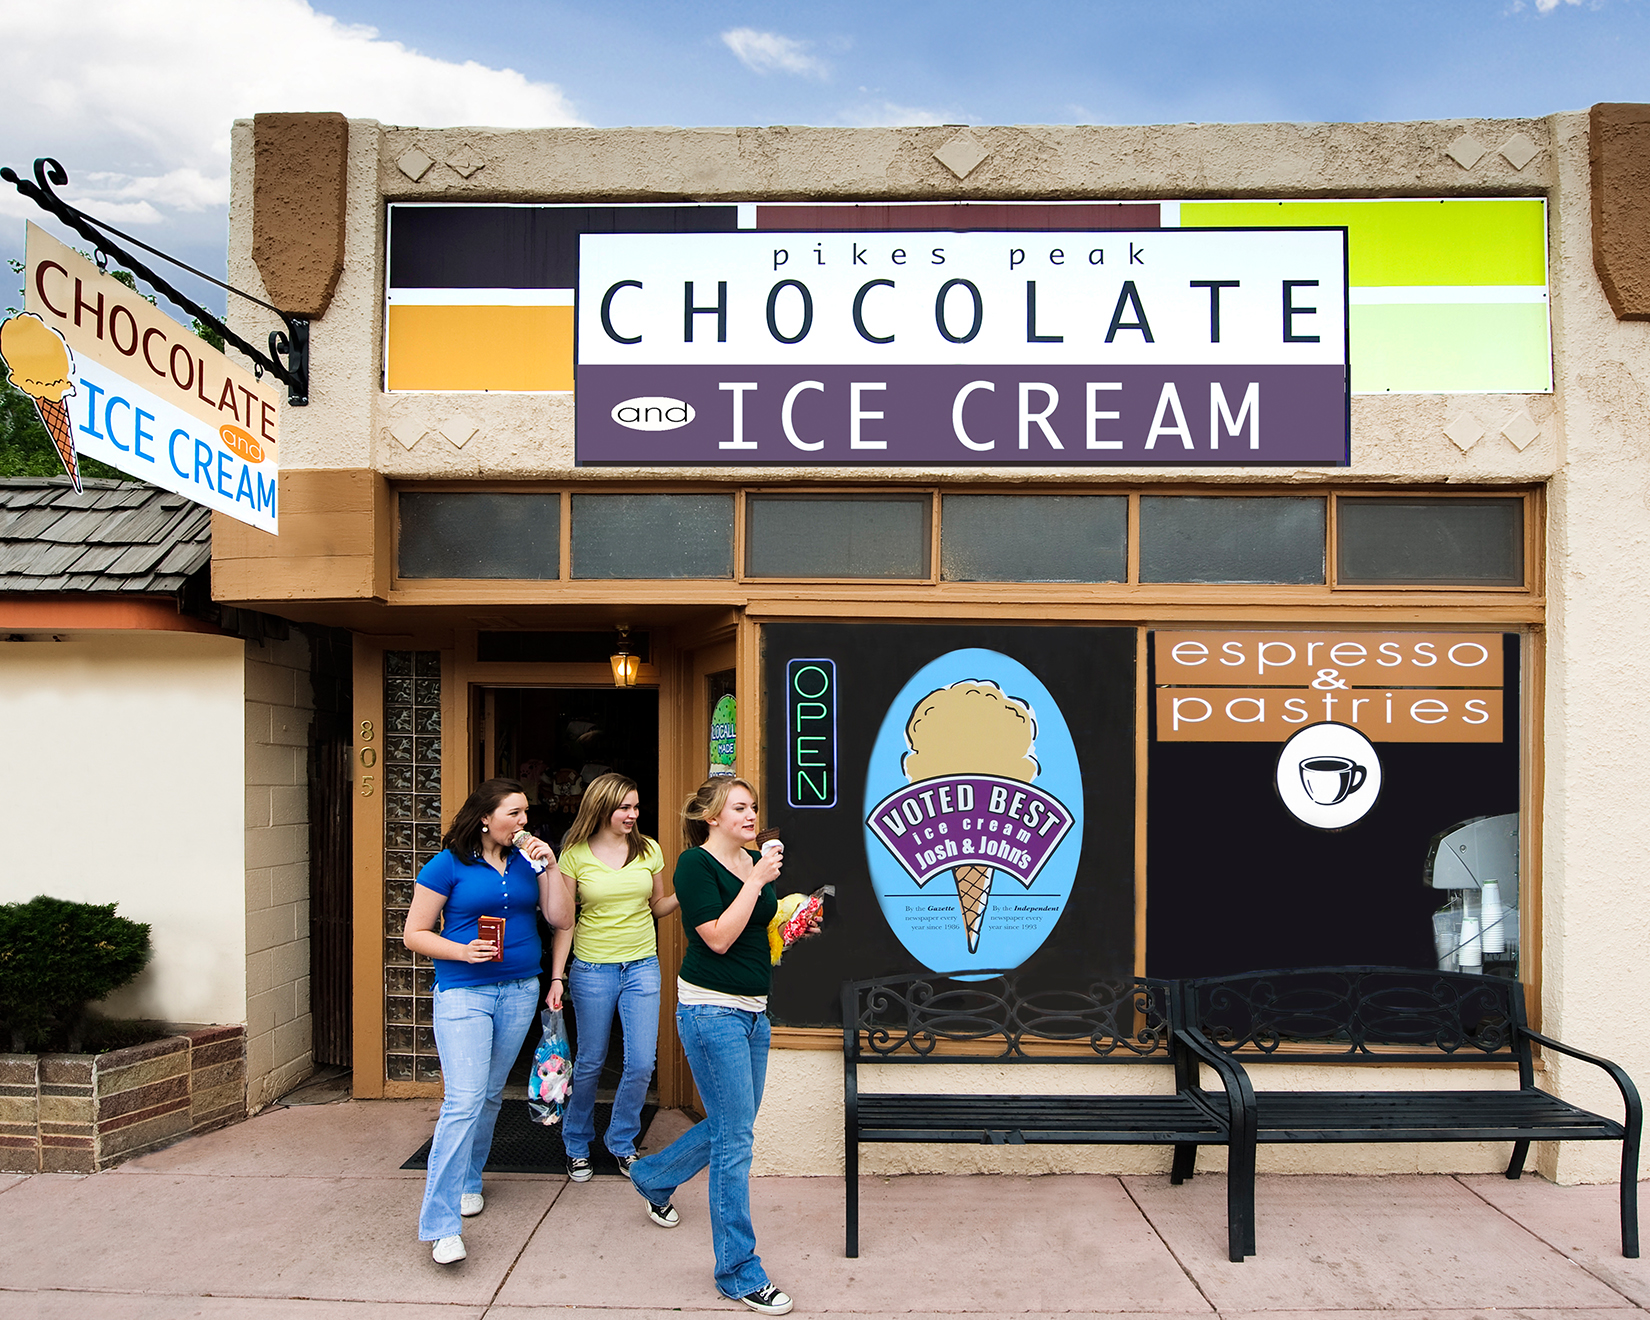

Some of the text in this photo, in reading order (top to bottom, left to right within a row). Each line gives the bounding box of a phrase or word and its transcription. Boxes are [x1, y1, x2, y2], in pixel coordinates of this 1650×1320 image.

[773, 242, 1146, 270] pikes peak
[600, 278, 1321, 344] CHOCOLATE
[35, 259, 276, 444] CHOCOLATE
[617, 380, 1260, 451] and ICE CREAM
[79, 378, 276, 519] ICE CREAM
[222, 427, 263, 462] and
[1171, 640, 1489, 675] espresso
[1311, 668, 1349, 690] &
[1172, 692, 1489, 731] pastries
[711, 723, 736, 740] LOCALL
[718, 742, 734, 754] MADE
[794, 665, 829, 801] OPEN
[360, 719, 377, 798] 805
[880, 783, 1062, 839] VOTED BEST
[912, 818, 1032, 846] ice cream
[914, 836, 1032, 871] Josh & John's
[1014, 905, 1060, 913] Independent
